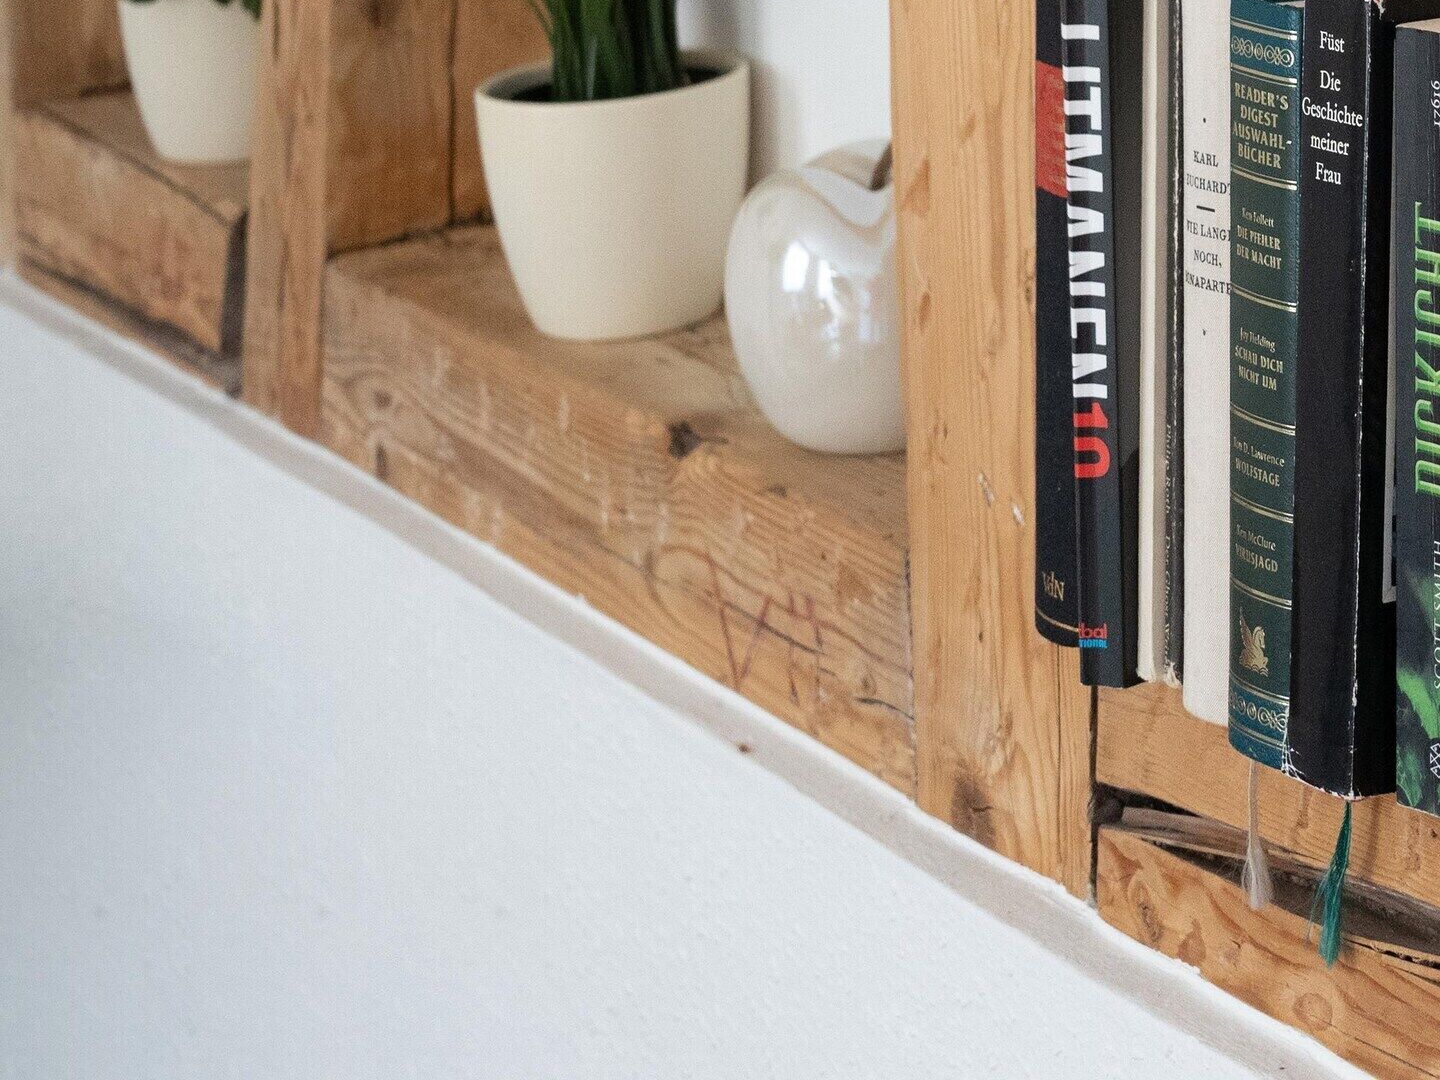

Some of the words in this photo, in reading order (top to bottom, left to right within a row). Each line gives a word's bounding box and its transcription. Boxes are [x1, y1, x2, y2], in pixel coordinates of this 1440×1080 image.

[1319, 30, 1346, 53] Füst
[1319, 69, 1342, 92] Die
[1234, 82, 1289, 110] READER'S
[1240, 105, 1278, 128] DIGEST
[1301, 96, 1364, 127] Geschichte
[1233, 121, 1292, 150] AUSWAHL-
[1310, 132, 1350, 156] meiner
[1193, 150, 1219, 168] KARL
[1238, 142, 1281, 169] BÜCHER
[1315, 161, 1342, 185] Frau
[1250, 230, 1281, 251] PFEILER
[1194, 249, 1222, 268] NOCH,
[1251, 249, 1282, 270] MACHT
[1260, 355, 1284, 374] DICH
[1262, 375, 1277, 391] UM
[1250, 445, 1286, 468] Lawrence
[1235, 457, 1281, 487] WOLFSTAGE
